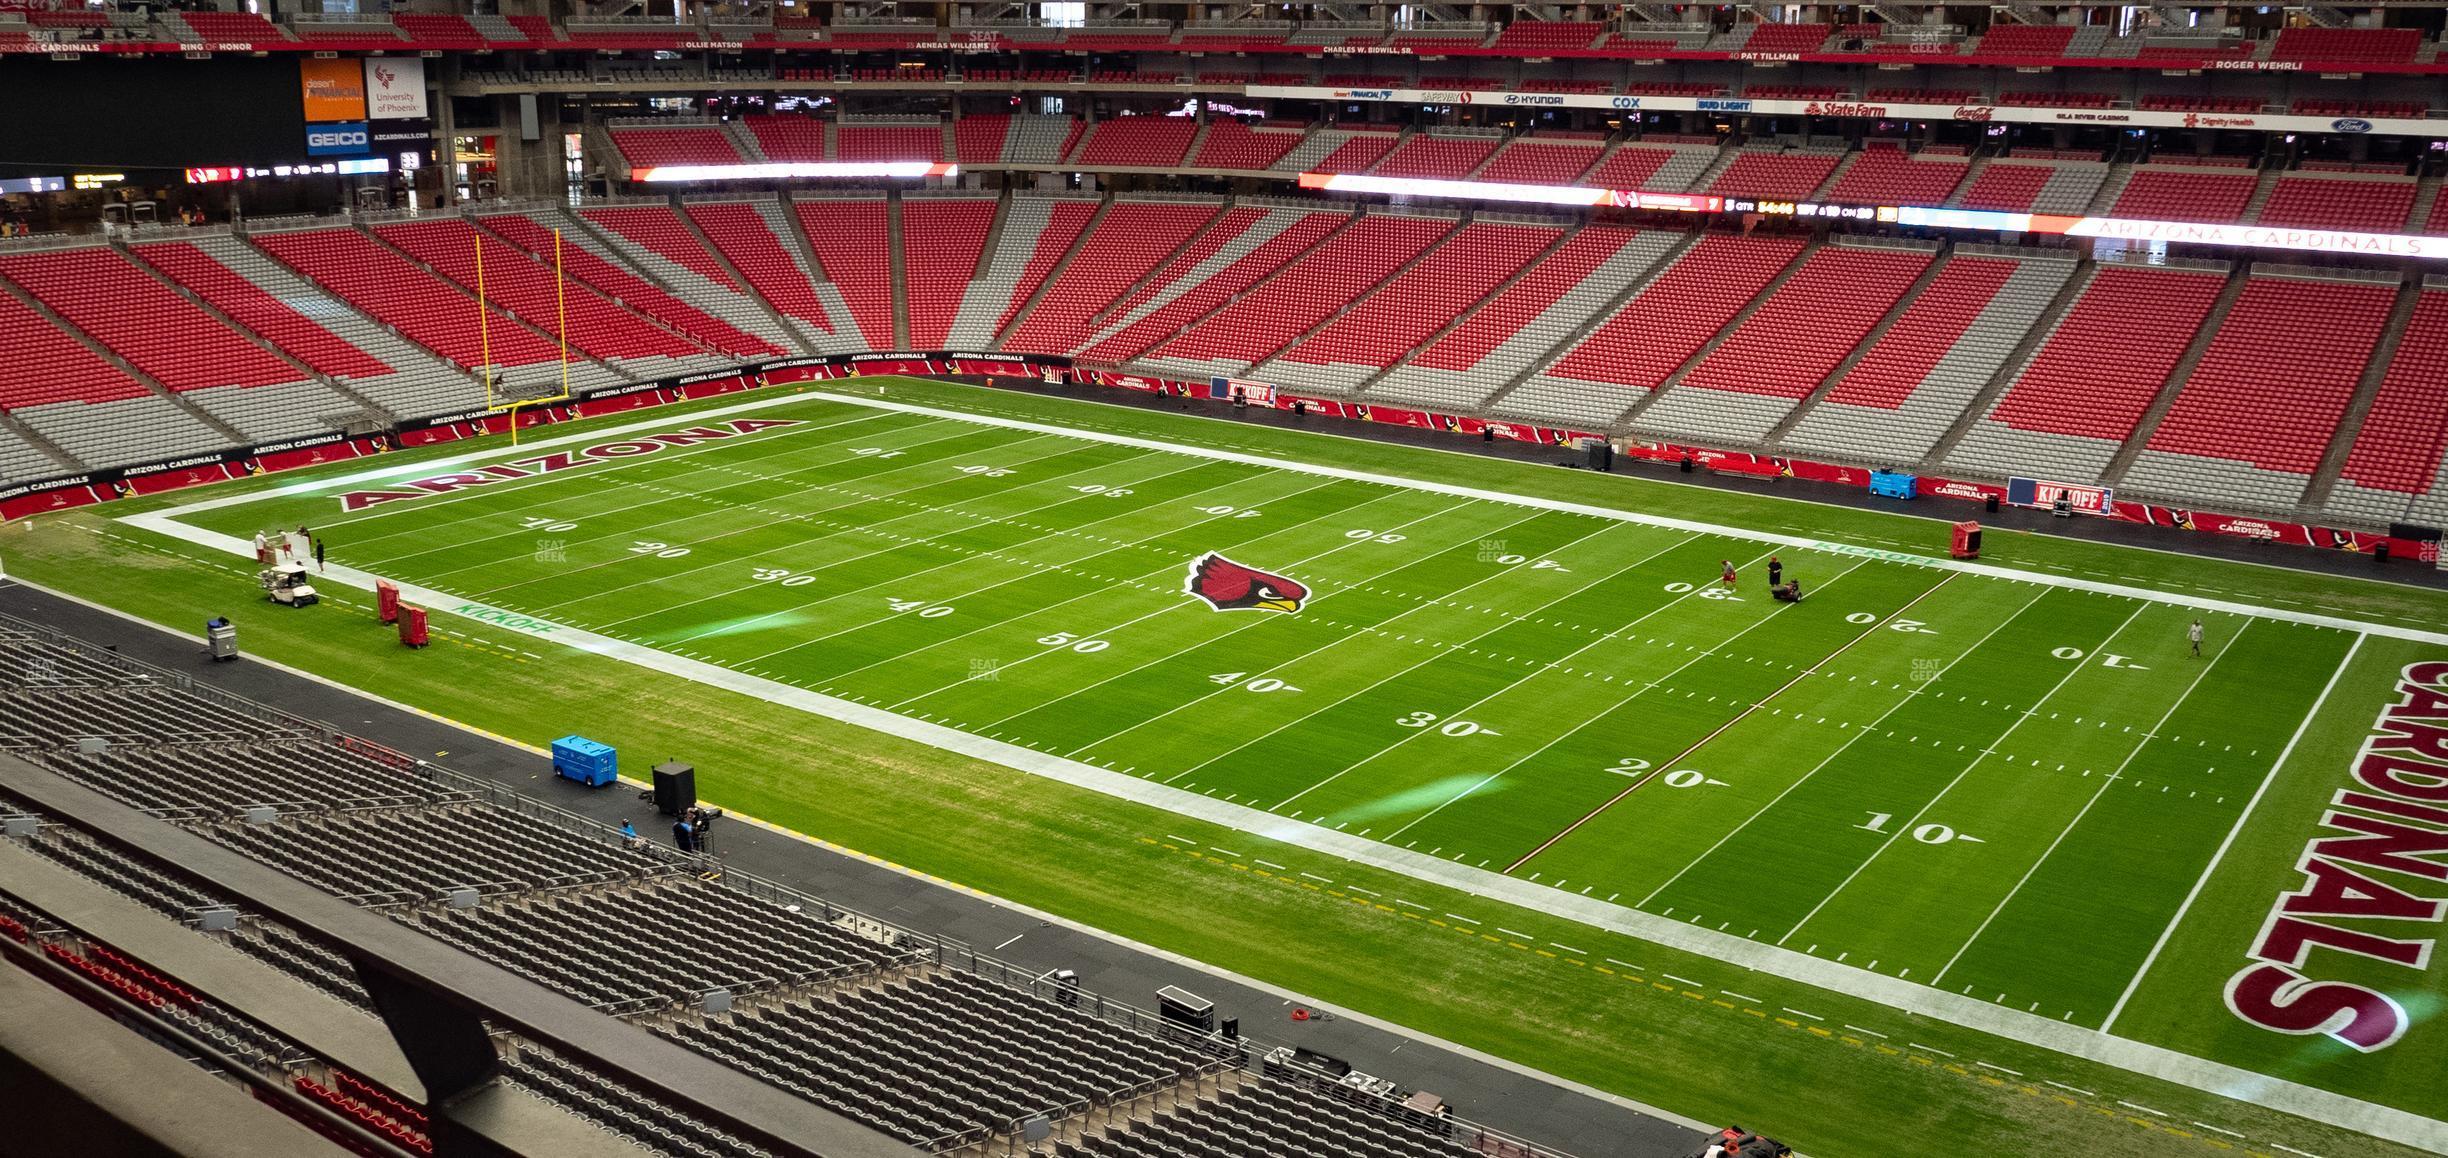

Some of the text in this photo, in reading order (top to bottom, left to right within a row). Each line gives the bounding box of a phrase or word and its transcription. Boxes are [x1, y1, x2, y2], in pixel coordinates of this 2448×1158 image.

[41, 44, 100, 52] CARDINALS
[180, 43, 252, 51] RING OF HONOR
[1368, 46, 1400, 55] BIDWILL,
[1741, 52, 1758, 60] PAT
[1760, 52, 1800, 61] TILLMAN
[2202, 61, 2302, 70] 22 ROGER WEHRLI
[376, 94, 415, 103] University
[1421, 92, 1460, 102] SAFEWAY
[1521, 96, 1564, 105] HYUNDAI
[1612, 97, 1640, 108] COX
[387, 104, 418, 112] Phoenix
[1698, 100, 1750, 111] BUD LIGHT
[2202, 117, 2254, 127] Dignity Health
[2338, 120, 2364, 130] Ford
[308, 132, 368, 146] GEICO
[1708, 200, 1718, 210] 7
[1736, 202, 1754, 212] QTR
[2098, 221, 2423, 254] ARIZONA CARDINALS
[762, 358, 828, 370] ARIZONA CARDINALS
[984, 354, 1024, 362] CARDINALS
[679, 369, 742, 384] ARIZONA CARDINALS
[1116, 379, 1150, 390] CARDINALS
[590, 382, 659, 400] ARIZONA CARDINALS
[1230, 382, 1268, 400] KCKOFF
[430, 414, 465, 426] ARIZONA
[1478, 426, 1519, 438] CDINALS
[254, 434, 343, 454] ARIZONA CARDINALS
[854, 447, 906, 459] 10
[1697, 450, 1726, 459] ARIZONA
[124, 454, 222, 476] ARIZONA CARDINALS
[327, 418, 811, 513] ARIZONA
[962, 466, 1017, 477] 20
[30, 476, 89, 491] CARDINALS
[1945, 482, 1978, 492] ARIZONA
[1078, 484, 1134, 498] 30
[1934, 486, 1989, 500] CARDINALS
[518, 518, 578, 532] 10
[2232, 519, 2270, 530] ARIZONA
[1344, 529, 1407, 544] 50
[628, 542, 691, 558] 20
[1813, 542, 1948, 566] KICKOFF
[755, 569, 816, 587] 30
[889, 600, 954, 619] 40
[451, 604, 564, 634] KICKOFF
[1037, 632, 1110, 654] 50
[2051, 646, 2136, 669] 10
[1209, 672, 1285, 694] 40
[1395, 710, 1483, 738] 30
[1604, 757, 1707, 788] 20
[1852, 810, 1956, 845] 10
